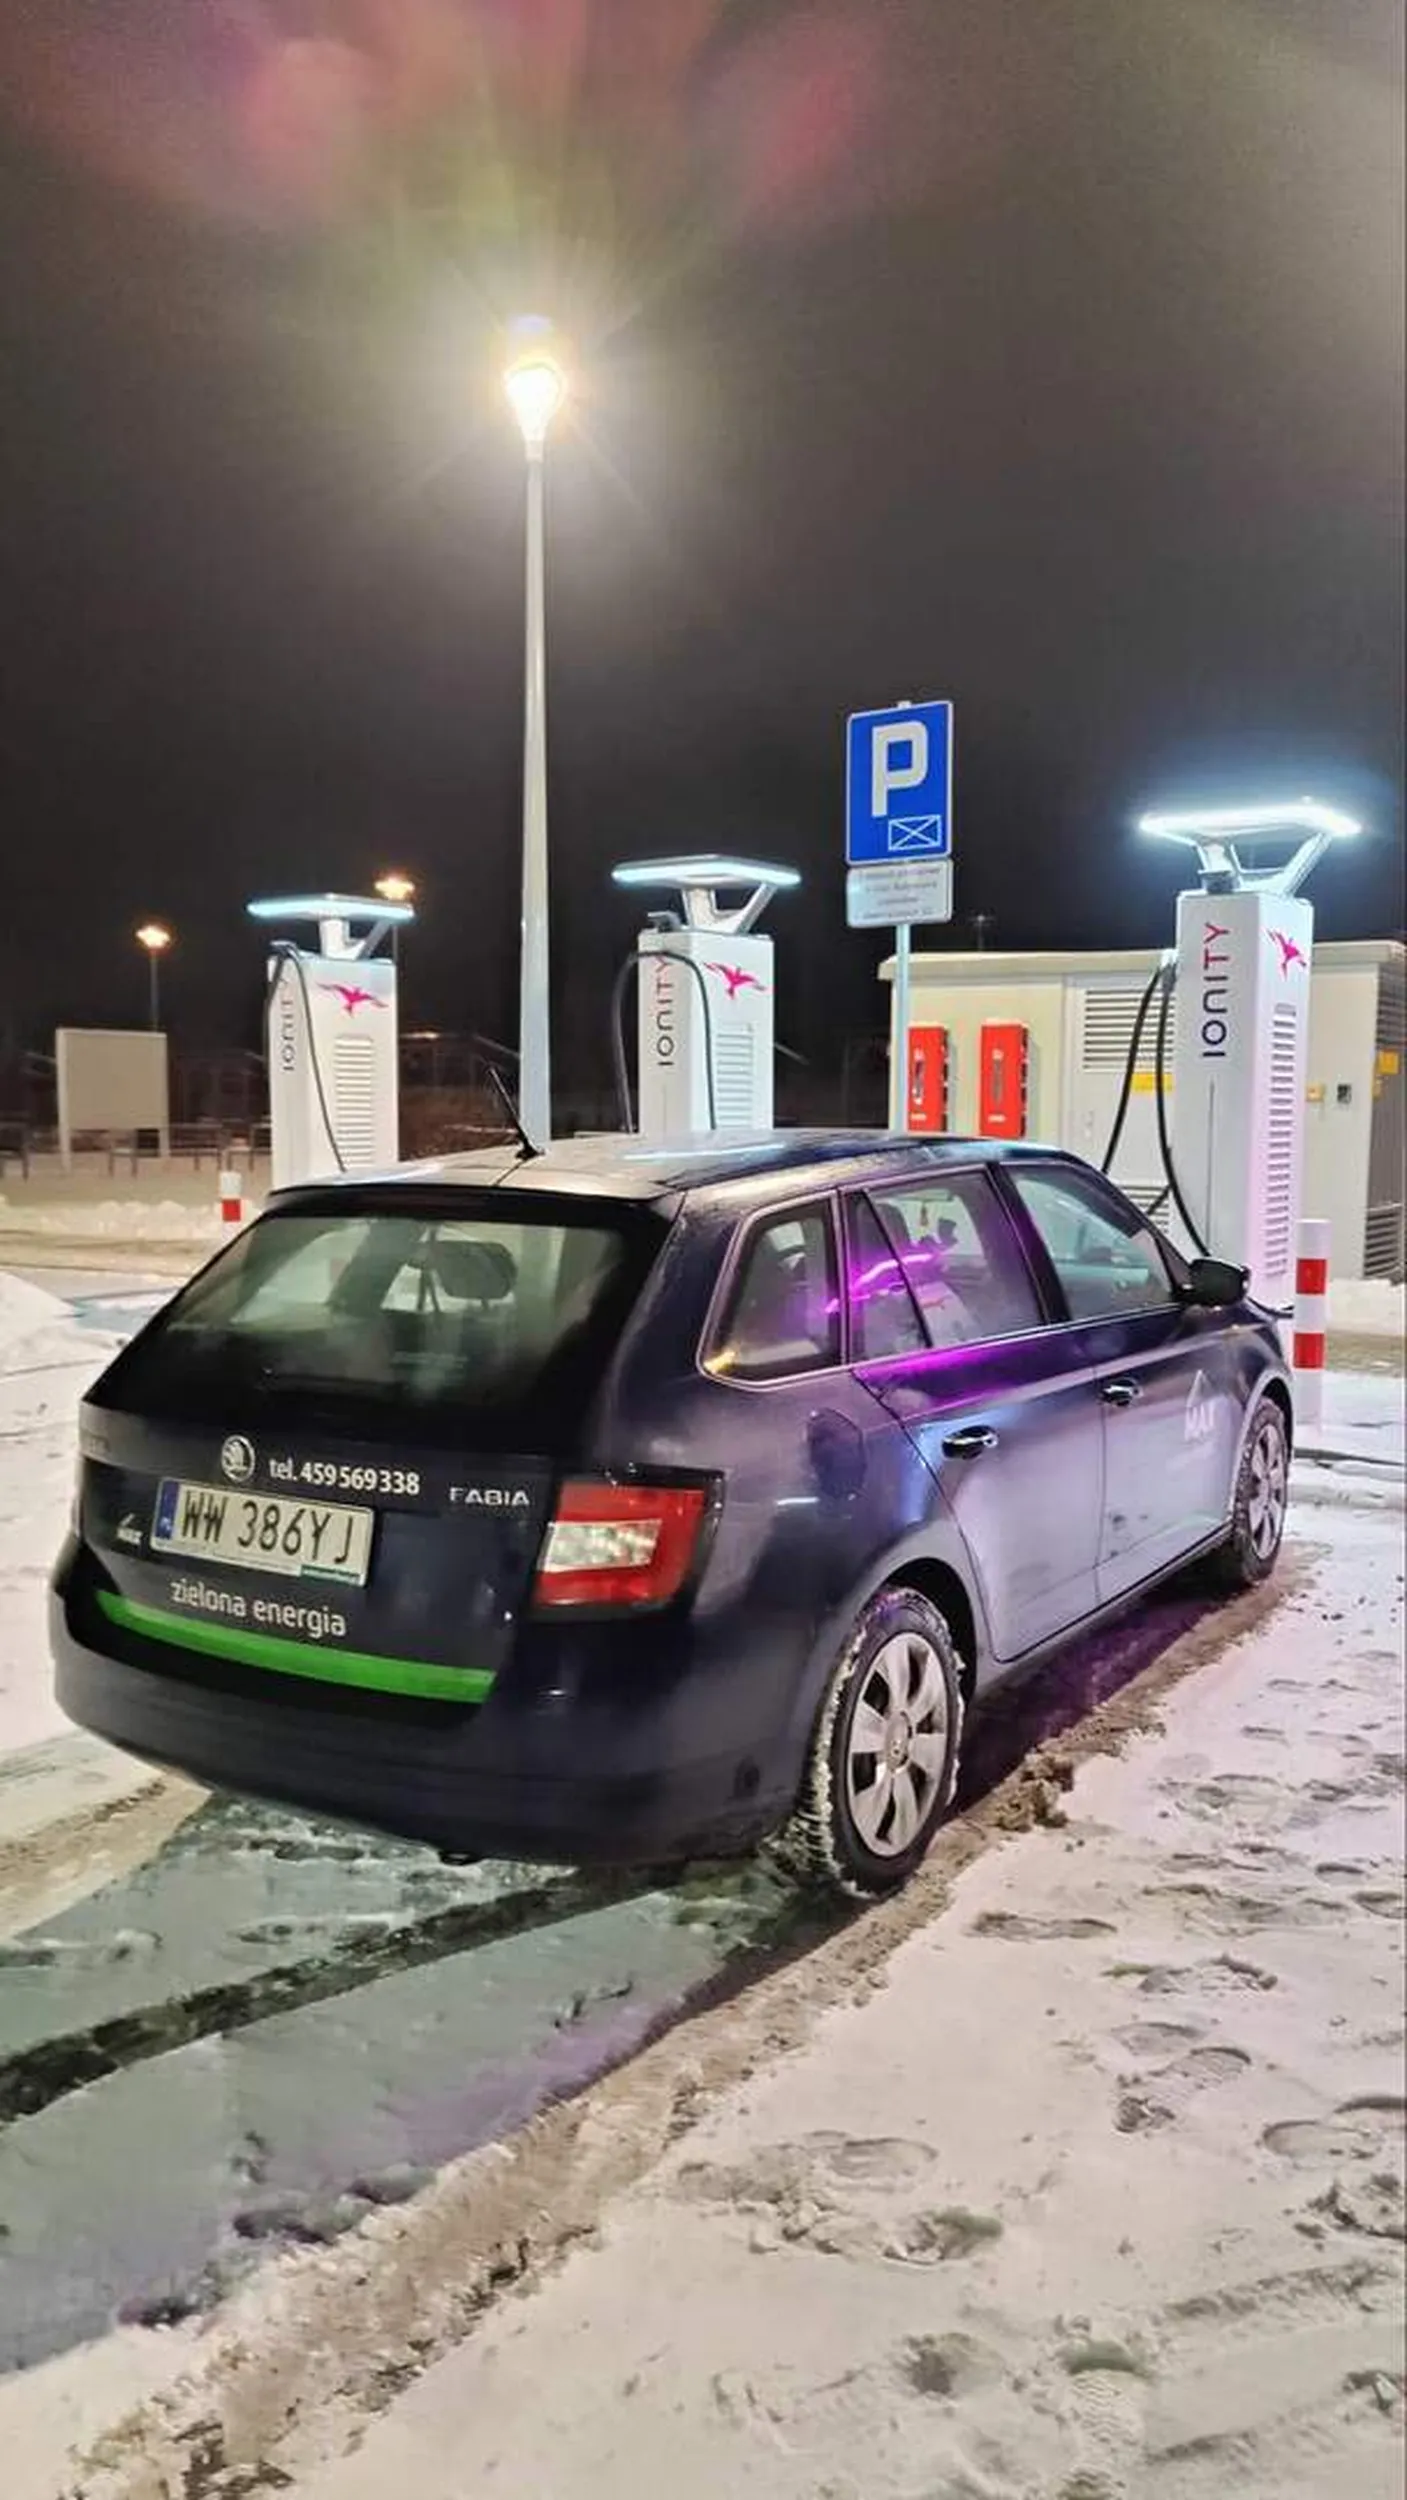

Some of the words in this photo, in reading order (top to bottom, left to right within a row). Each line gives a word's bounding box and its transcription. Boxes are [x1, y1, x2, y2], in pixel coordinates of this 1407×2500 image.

[872, 720, 928, 818] P
[181, 1490, 228, 1544] WW
[449, 1486, 530, 1507] FABIA
[170, 1577, 247, 1617] zielona
[252, 1599, 347, 1640] energia
